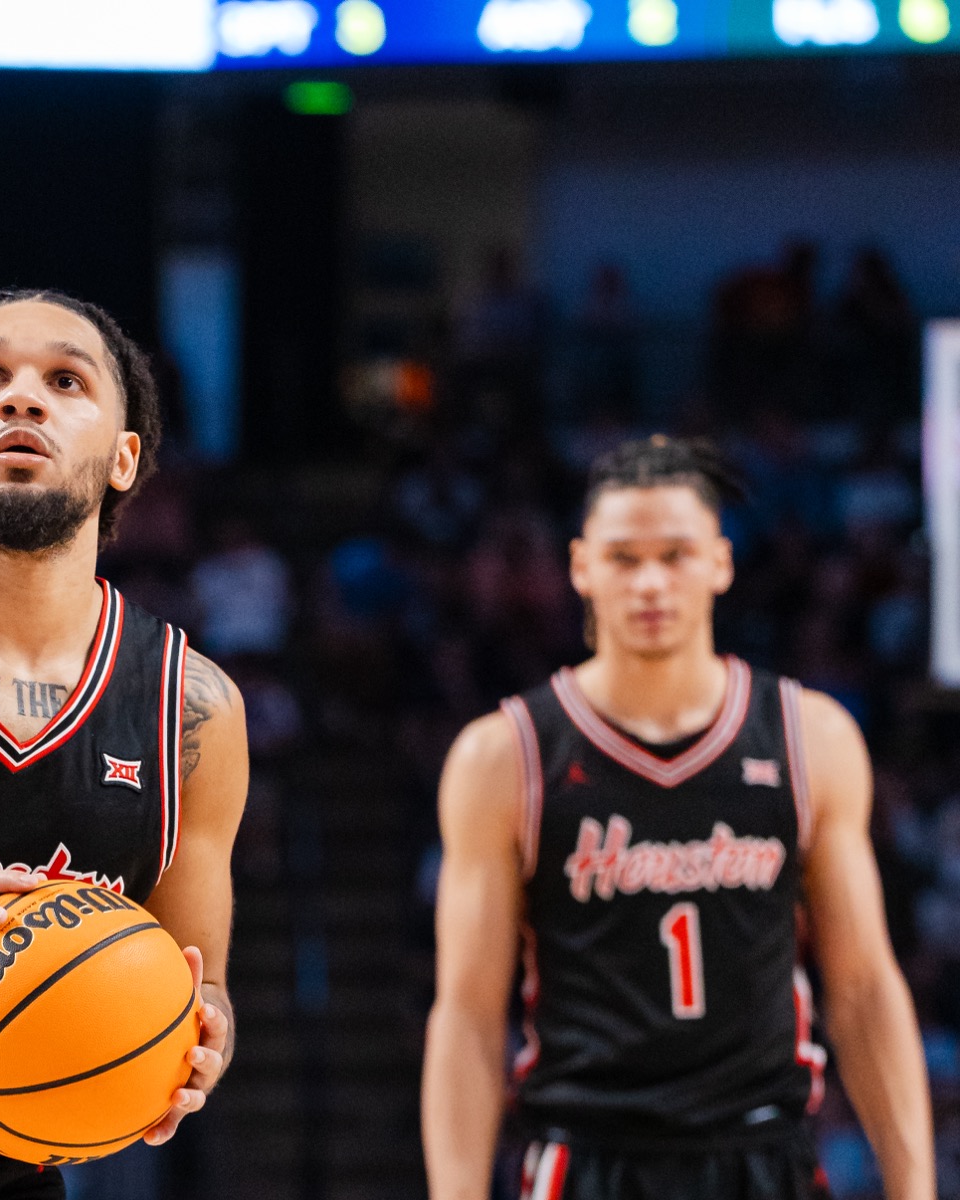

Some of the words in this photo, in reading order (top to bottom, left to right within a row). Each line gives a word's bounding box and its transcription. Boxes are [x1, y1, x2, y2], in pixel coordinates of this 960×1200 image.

[11, 676, 69, 720] THE
[564, 814, 786, 902] Houston
[659, 902, 706, 1020] 1
